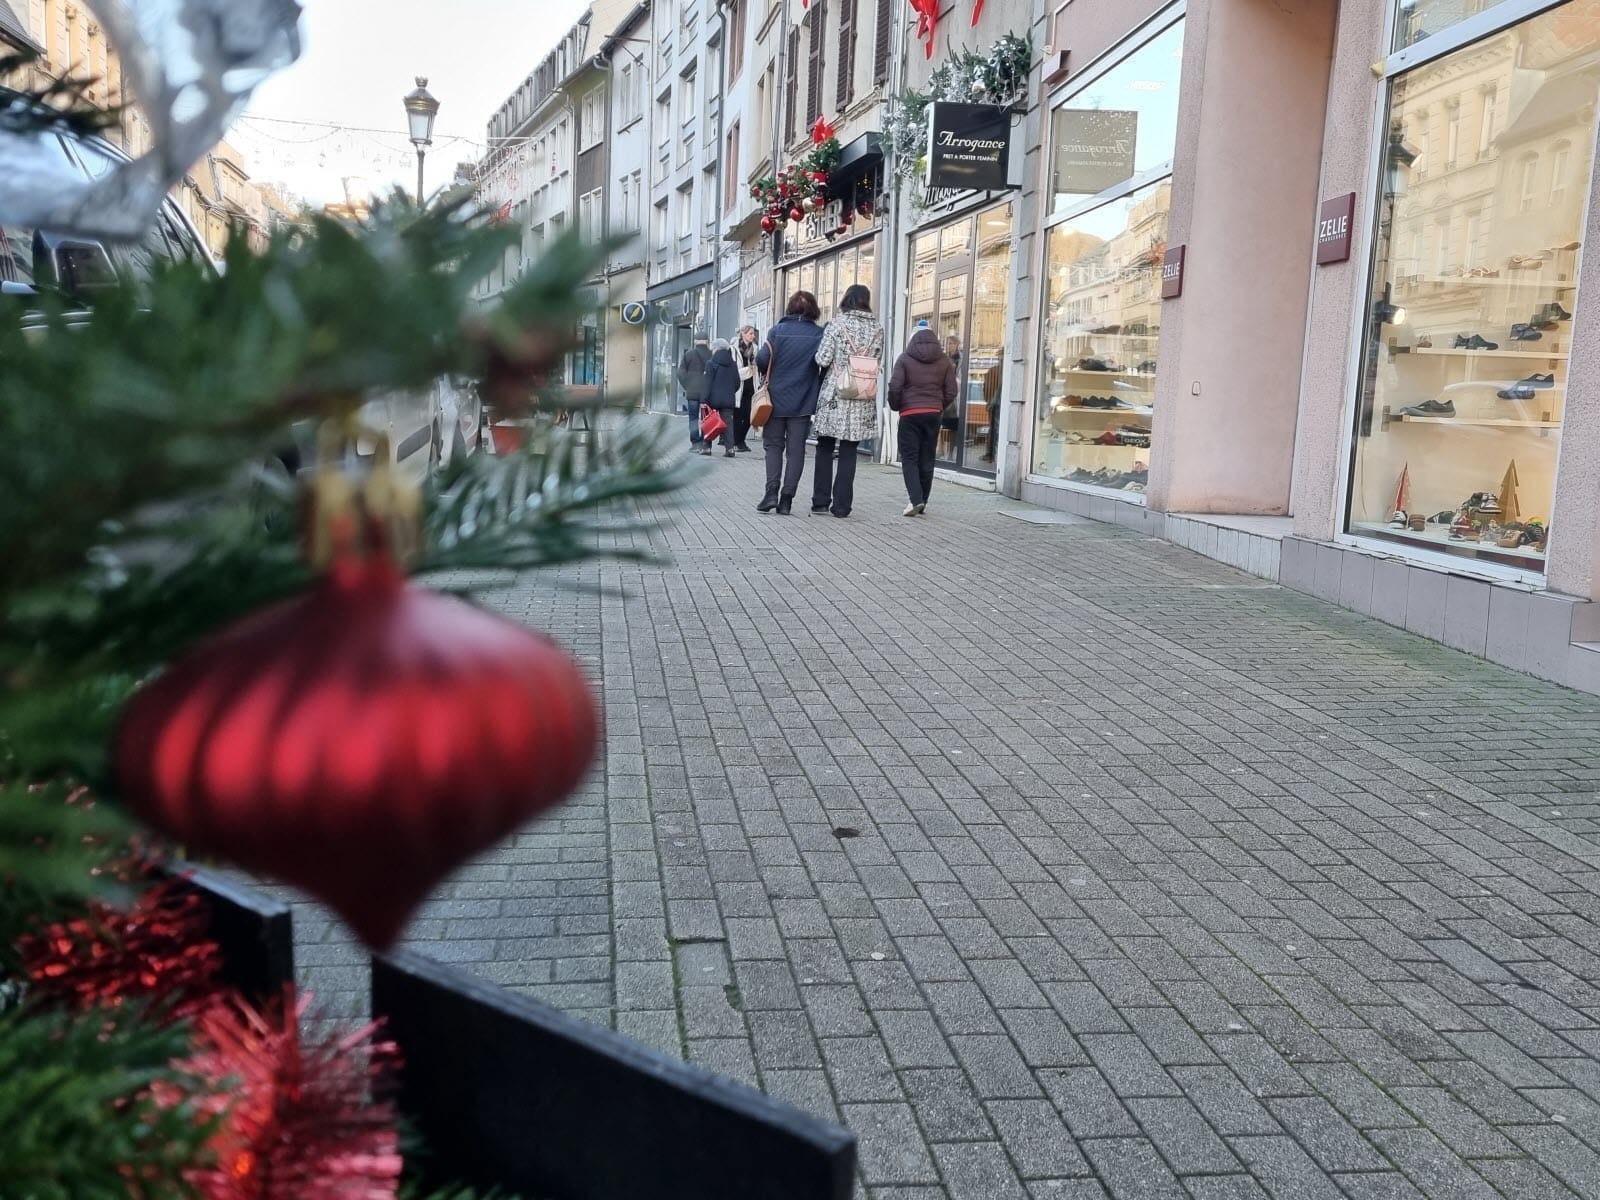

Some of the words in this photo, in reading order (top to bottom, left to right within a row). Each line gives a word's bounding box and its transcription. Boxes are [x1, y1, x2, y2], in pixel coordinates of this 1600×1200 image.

[937, 130, 1006, 152] Arrogance
[1320, 215, 1347, 237] ZELIE
[1163, 262, 1180, 278] ZELIE
